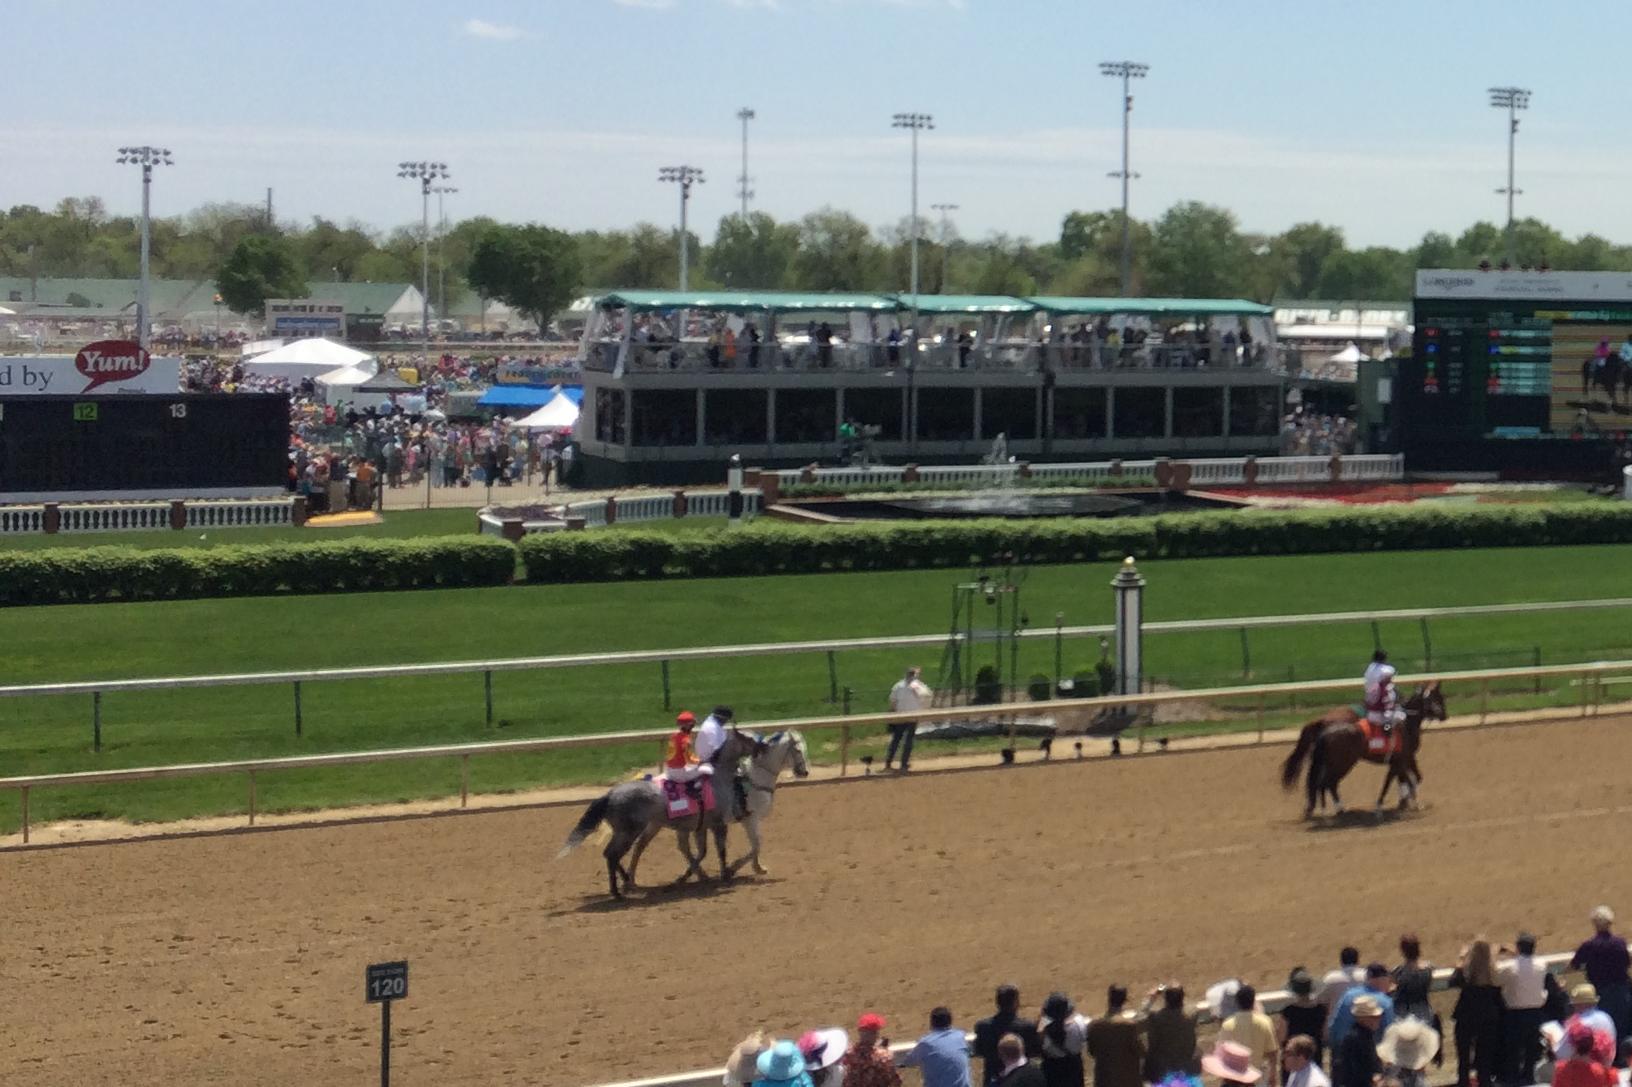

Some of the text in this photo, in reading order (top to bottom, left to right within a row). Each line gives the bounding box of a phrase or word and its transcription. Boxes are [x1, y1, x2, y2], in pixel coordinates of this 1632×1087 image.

[22, 365, 54, 391] by
[81, 350, 146, 372] Yum!
[78, 403, 187, 419] 12 13
[371, 977, 405, 997] 120
